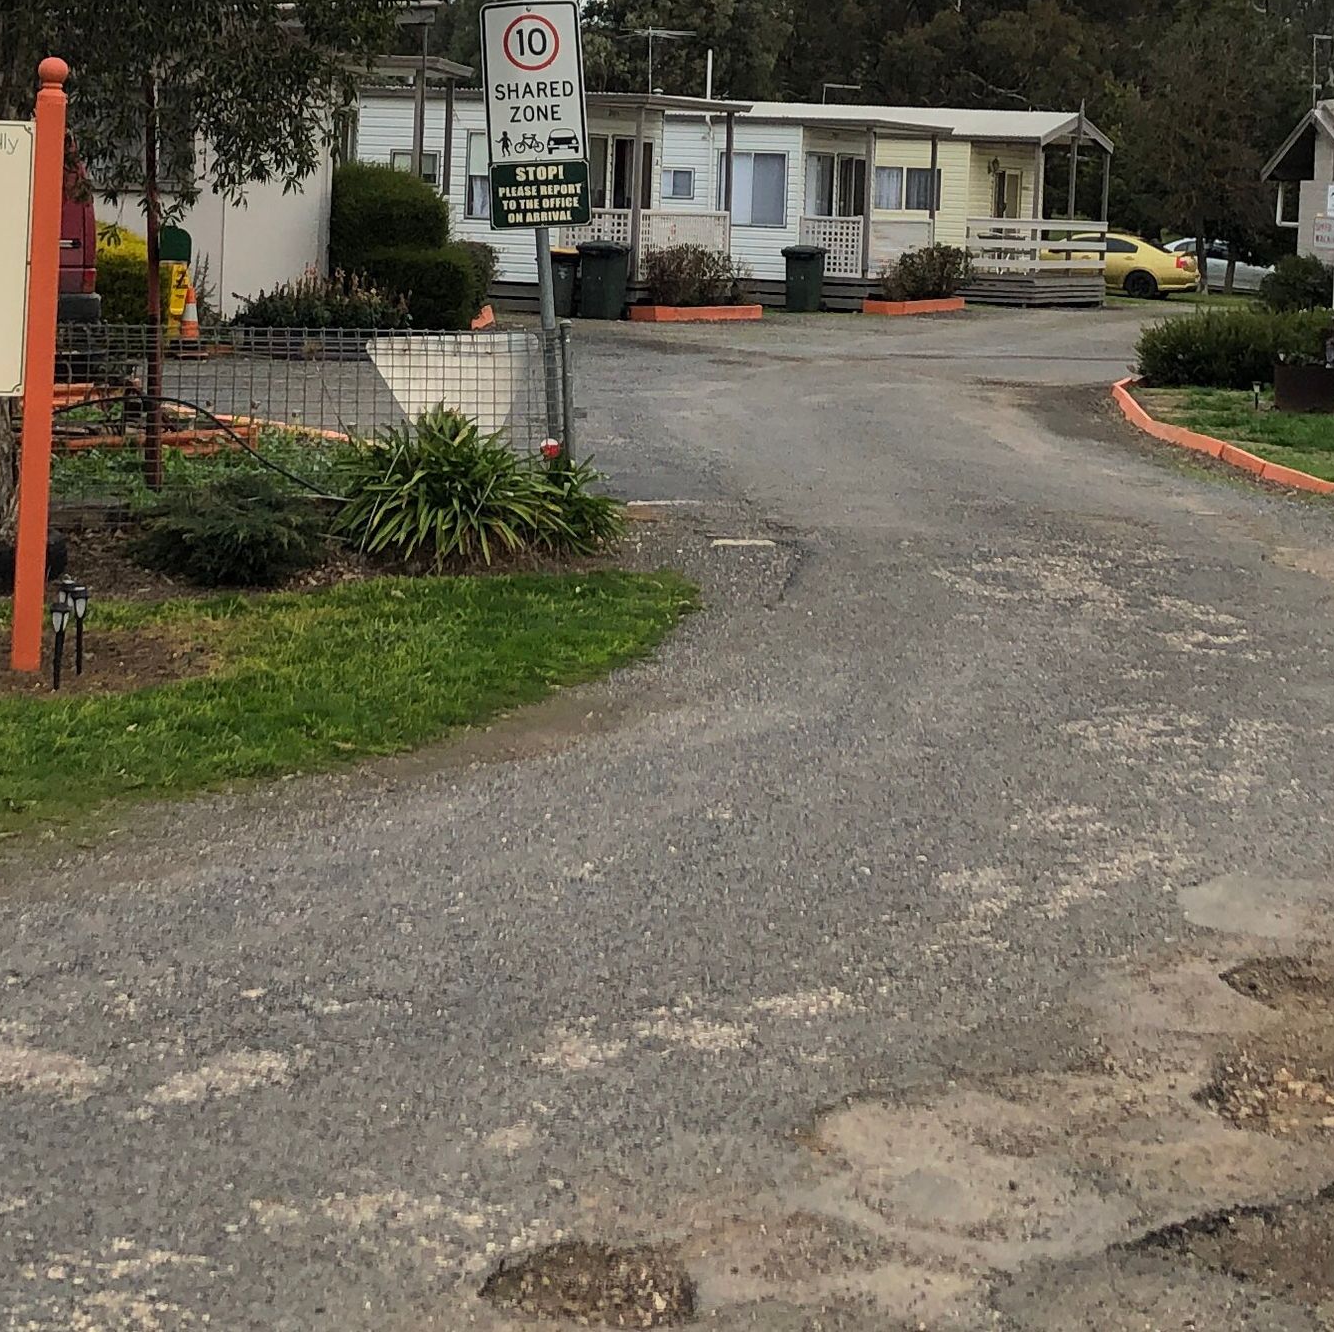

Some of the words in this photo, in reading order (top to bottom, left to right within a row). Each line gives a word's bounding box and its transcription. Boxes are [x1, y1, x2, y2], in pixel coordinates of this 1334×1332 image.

[516, 28, 547, 56] 10
[495, 81, 574, 100] SHARED
[510, 105, 562, 123] ZONE
[515, 165, 564, 181] STOP!
[498, 186, 537, 197] PLEASE
[540, 183, 582, 195] REPORT
[502, 200, 517, 210] TO
[519, 199, 540, 209] THE
[542, 197, 580, 208] OFFICE
[508, 213, 523, 223] ON
[526, 211, 572, 222] ARRIVAL
